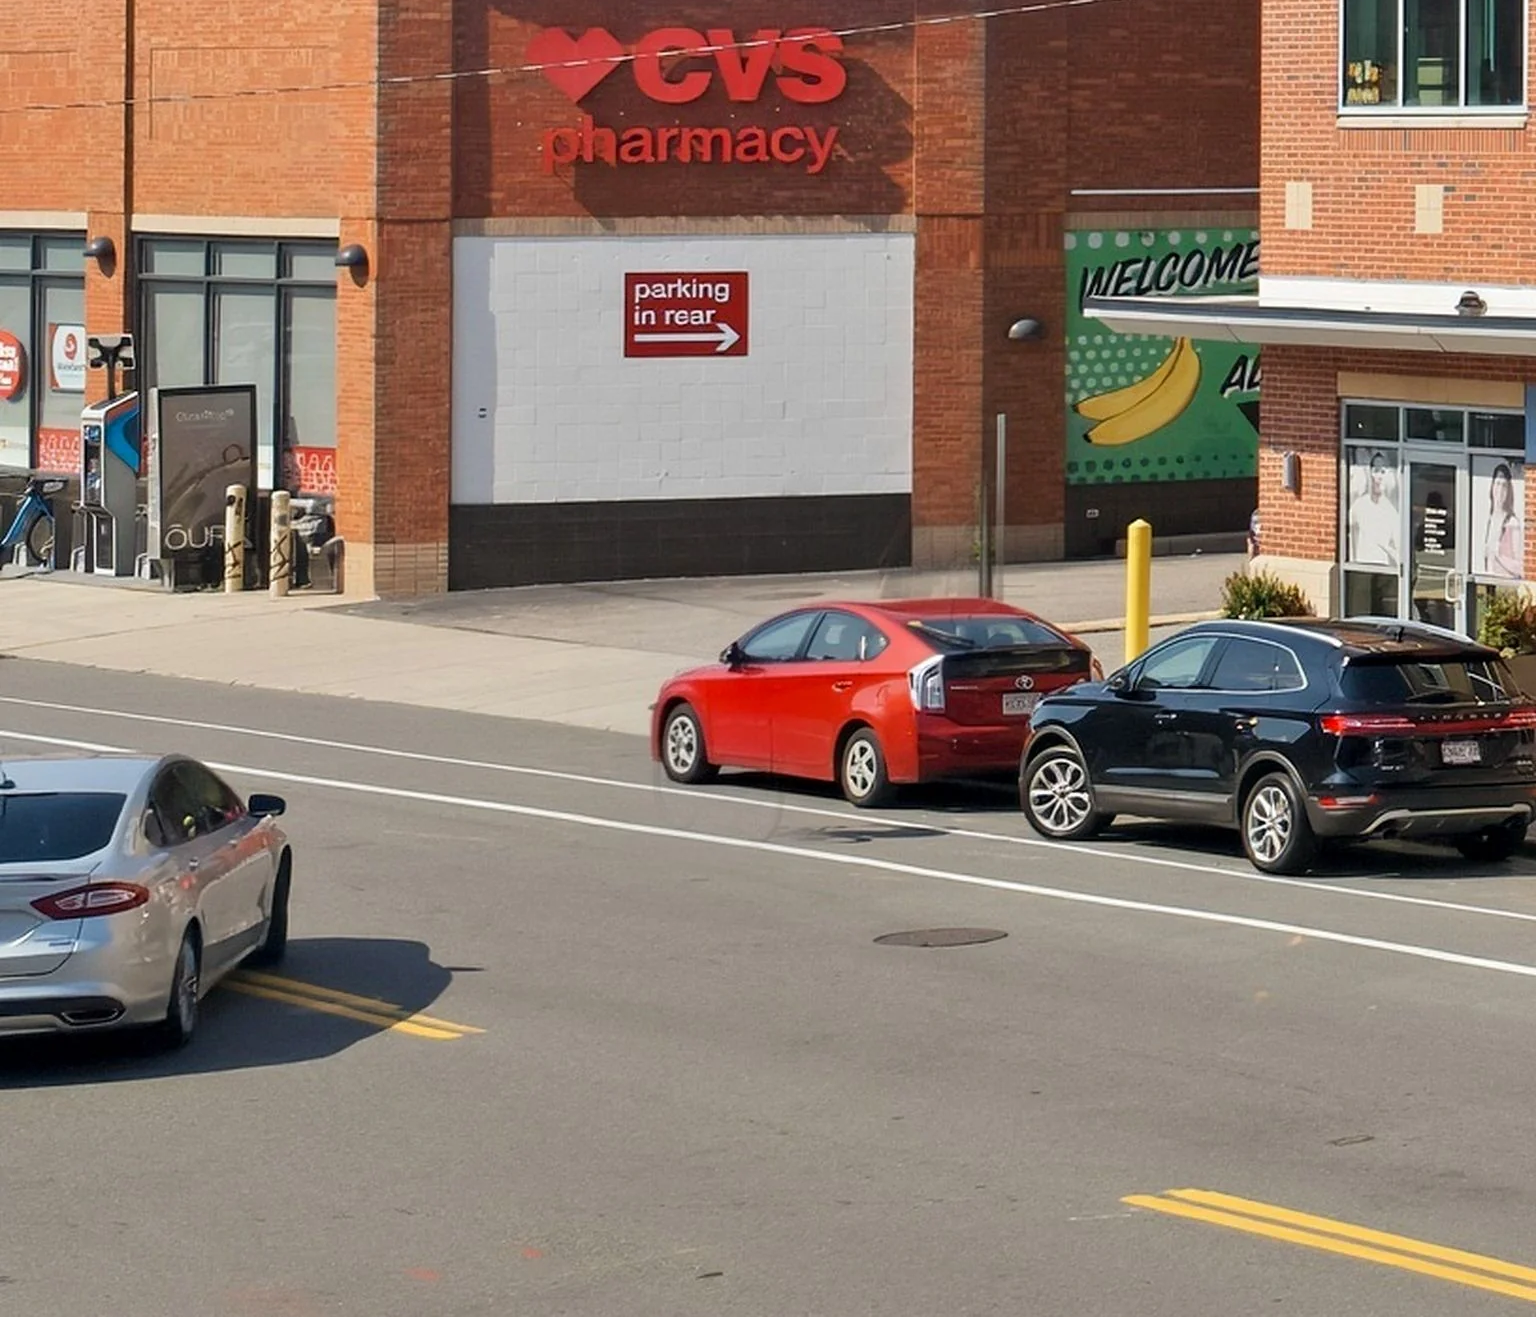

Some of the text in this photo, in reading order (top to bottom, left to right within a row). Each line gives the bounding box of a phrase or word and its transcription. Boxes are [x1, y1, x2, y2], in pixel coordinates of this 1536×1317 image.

[633, 26, 848, 104] CVS
[543, 115, 838, 174] pharmacy
[634, 278, 729, 303] parking
[1080, 240, 1260, 312] WELCOME
[634, 305, 717, 325] in rear
